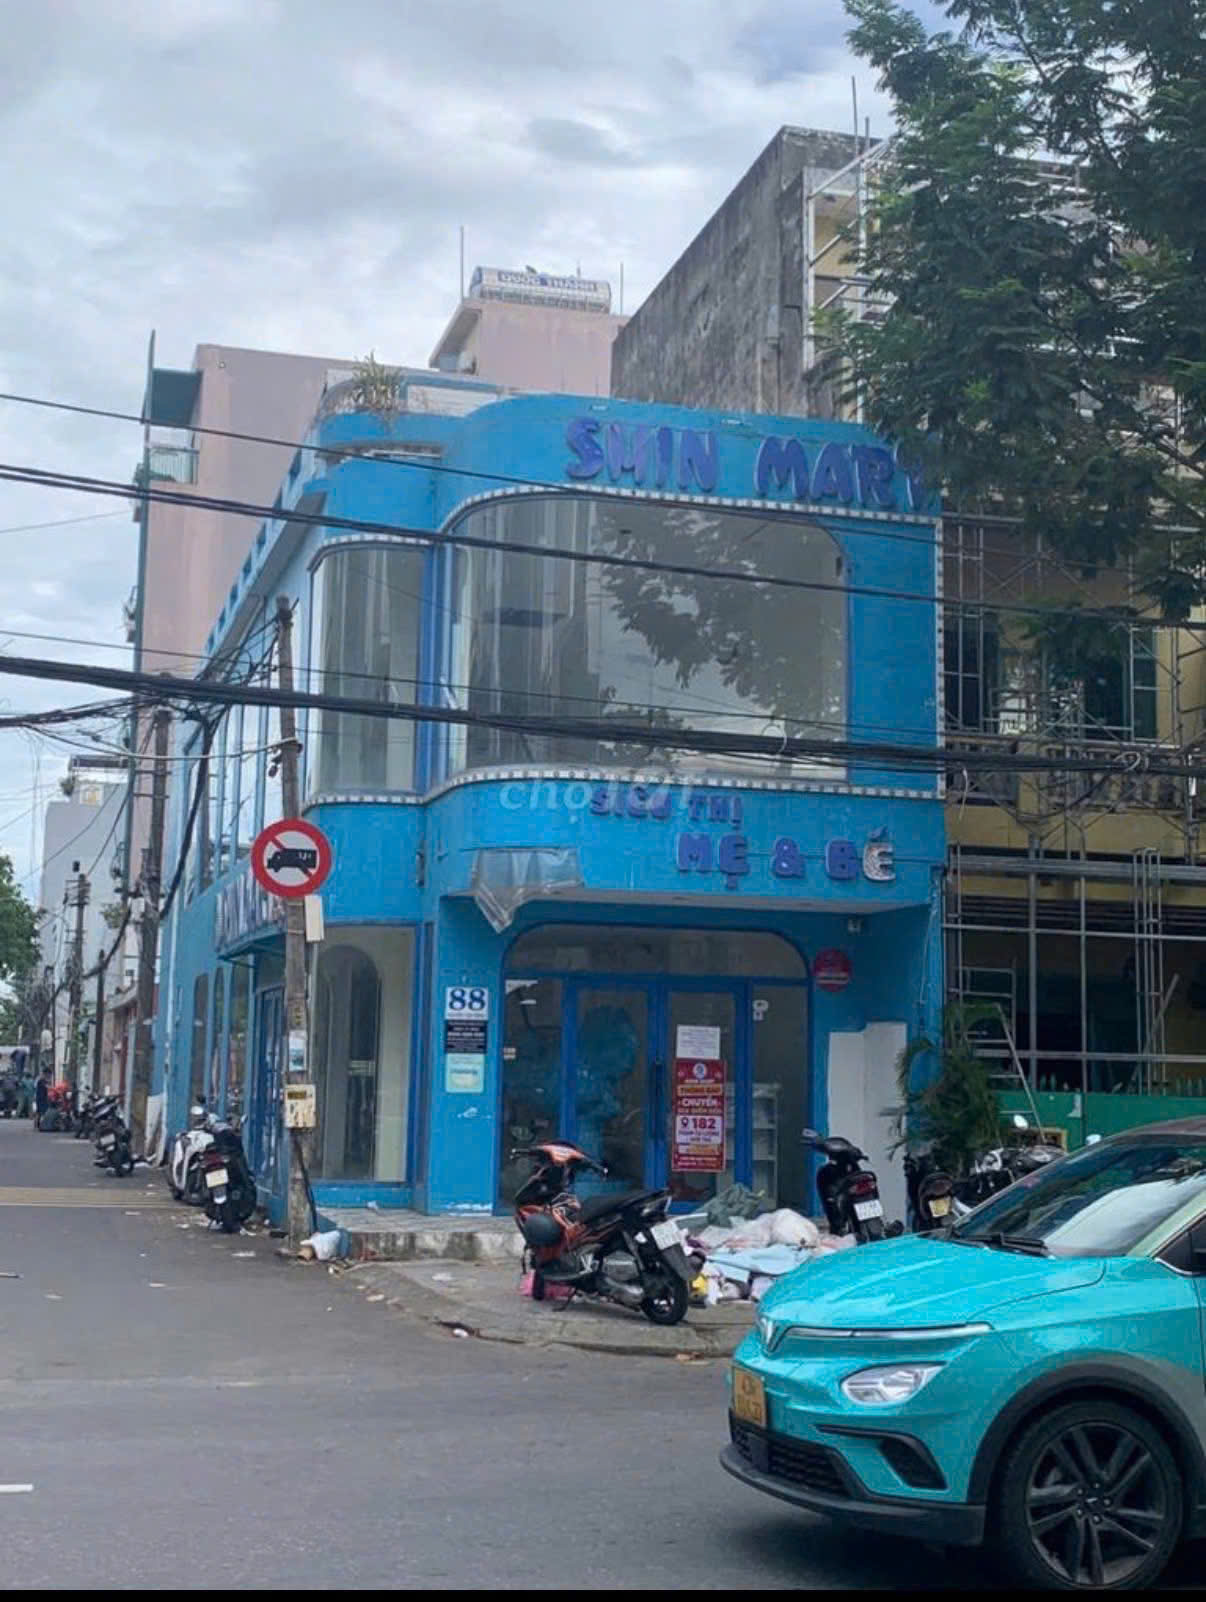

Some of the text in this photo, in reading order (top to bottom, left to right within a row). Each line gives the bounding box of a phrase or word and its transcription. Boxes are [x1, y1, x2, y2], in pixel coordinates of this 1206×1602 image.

[565, 417, 719, 492] SHIN
[676, 826, 896, 888] MẸ & BÉ
[449, 988, 486, 1010] 88
[692, 1117, 716, 1129] 182
